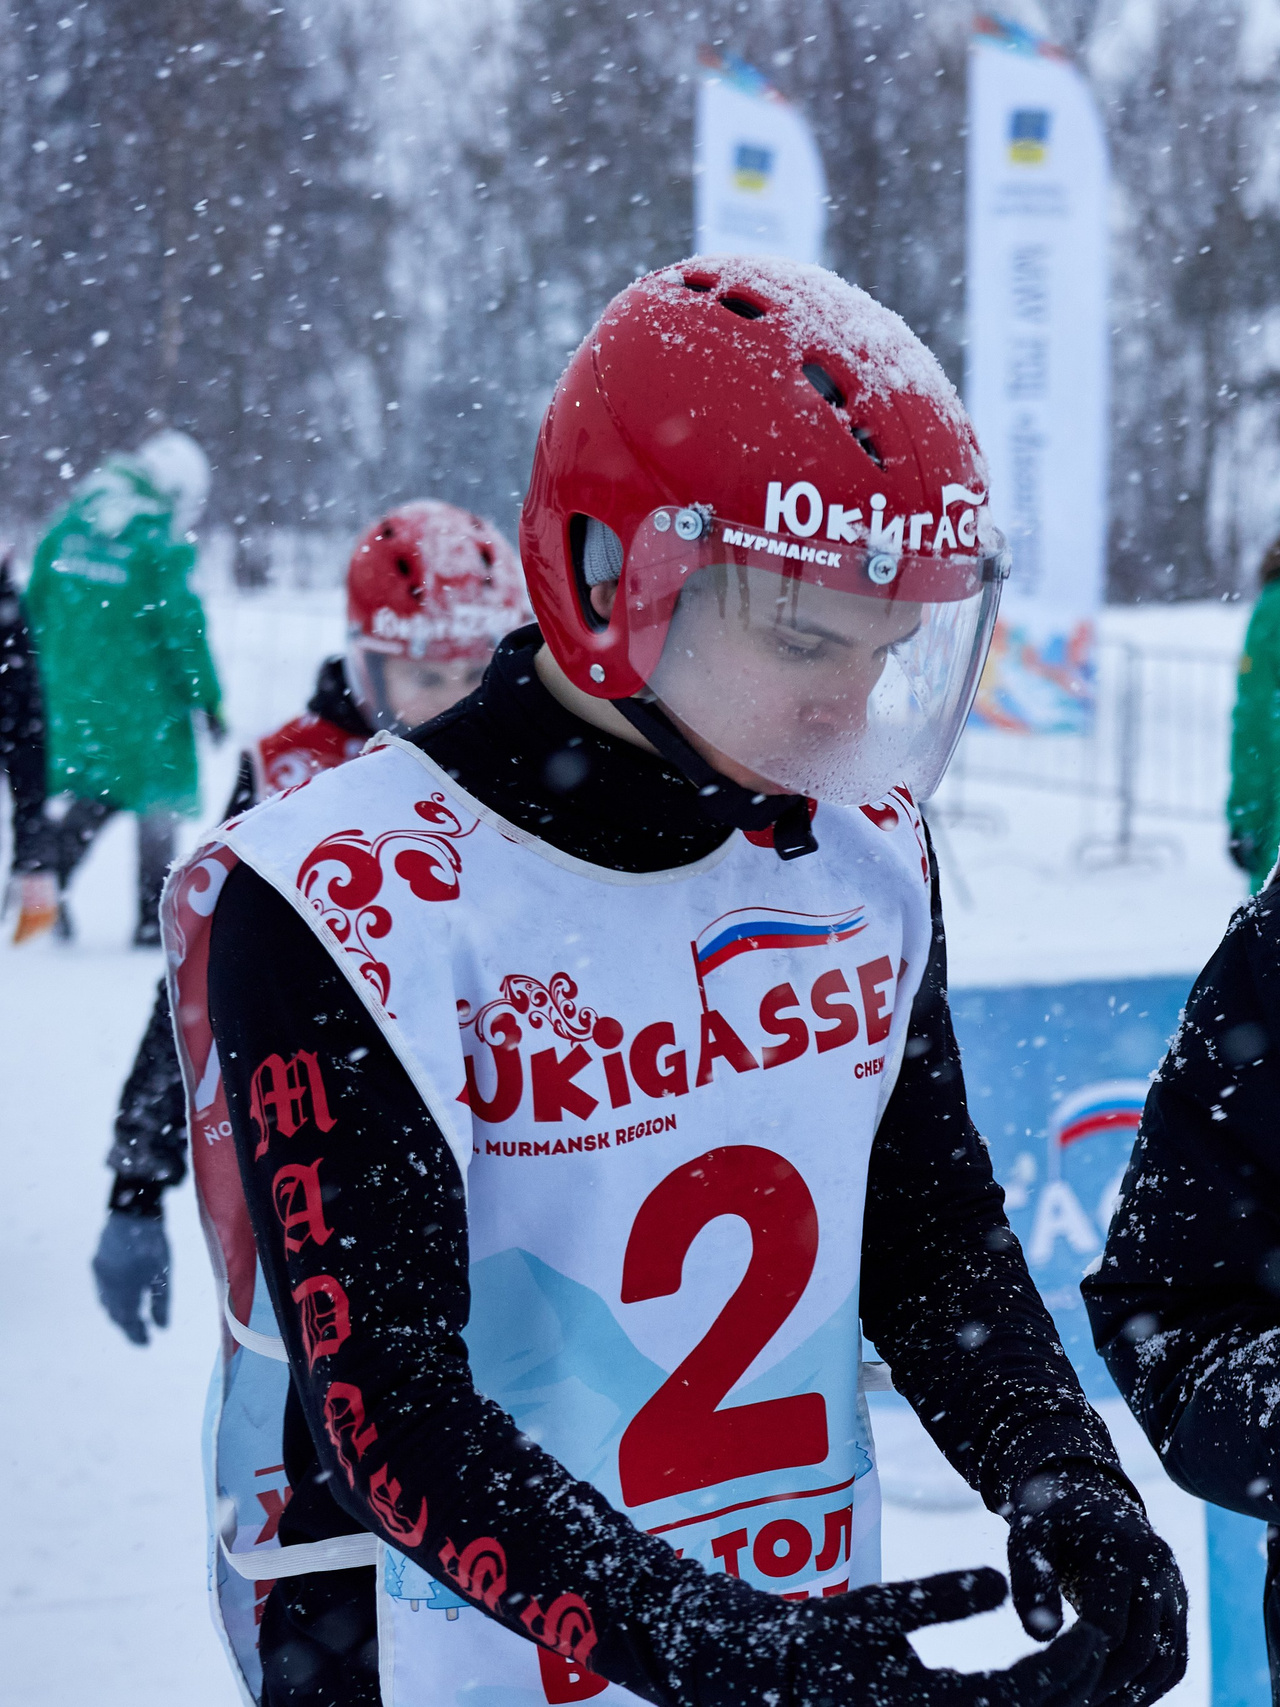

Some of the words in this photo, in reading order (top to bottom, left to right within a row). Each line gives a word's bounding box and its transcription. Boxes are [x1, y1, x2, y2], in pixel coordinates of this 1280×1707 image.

[722, 528, 842, 568] МУРМАНСК
[486, 1132, 610, 1157] MURMANSK
[615, 1113, 677, 1147] REGION
[619, 1145, 829, 1507] 2
[711, 1503, 853, 1579] ТОЛ
